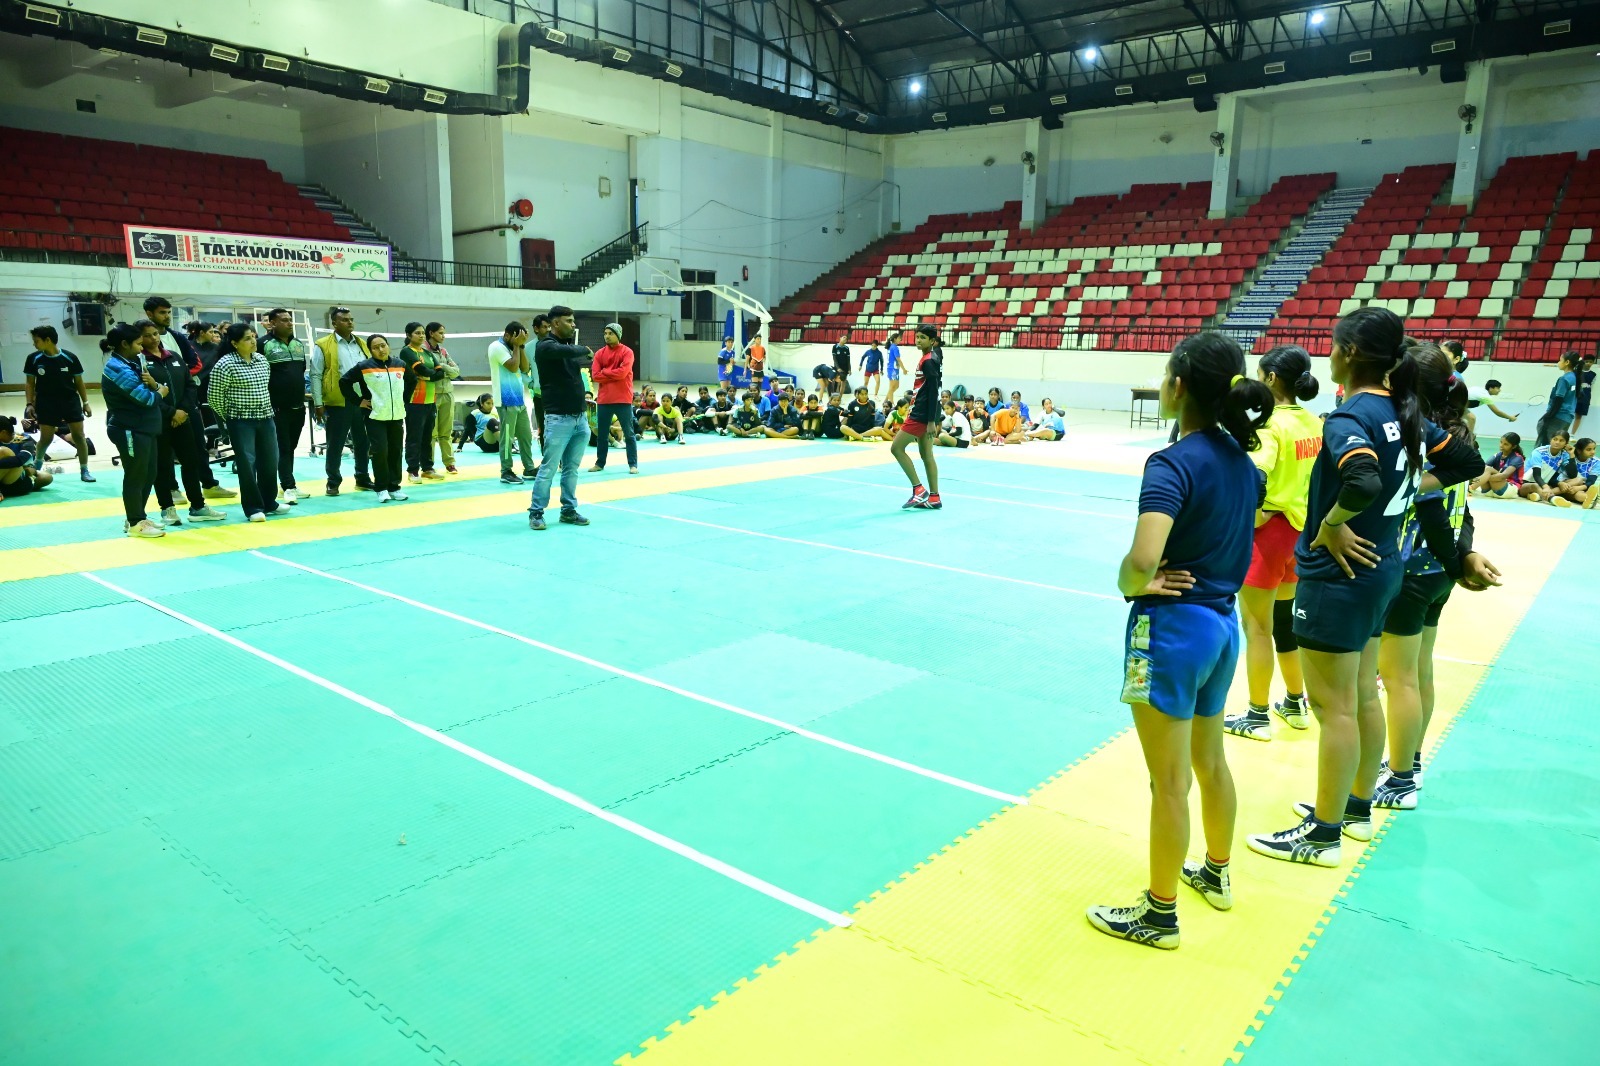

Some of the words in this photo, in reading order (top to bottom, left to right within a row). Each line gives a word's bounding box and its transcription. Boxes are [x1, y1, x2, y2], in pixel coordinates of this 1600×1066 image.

[200, 242, 322, 263] TAEKWONDO
[203, 256, 288, 267] CHAMPIONSHIP
[291, 261, 320, 269] 2025-26
